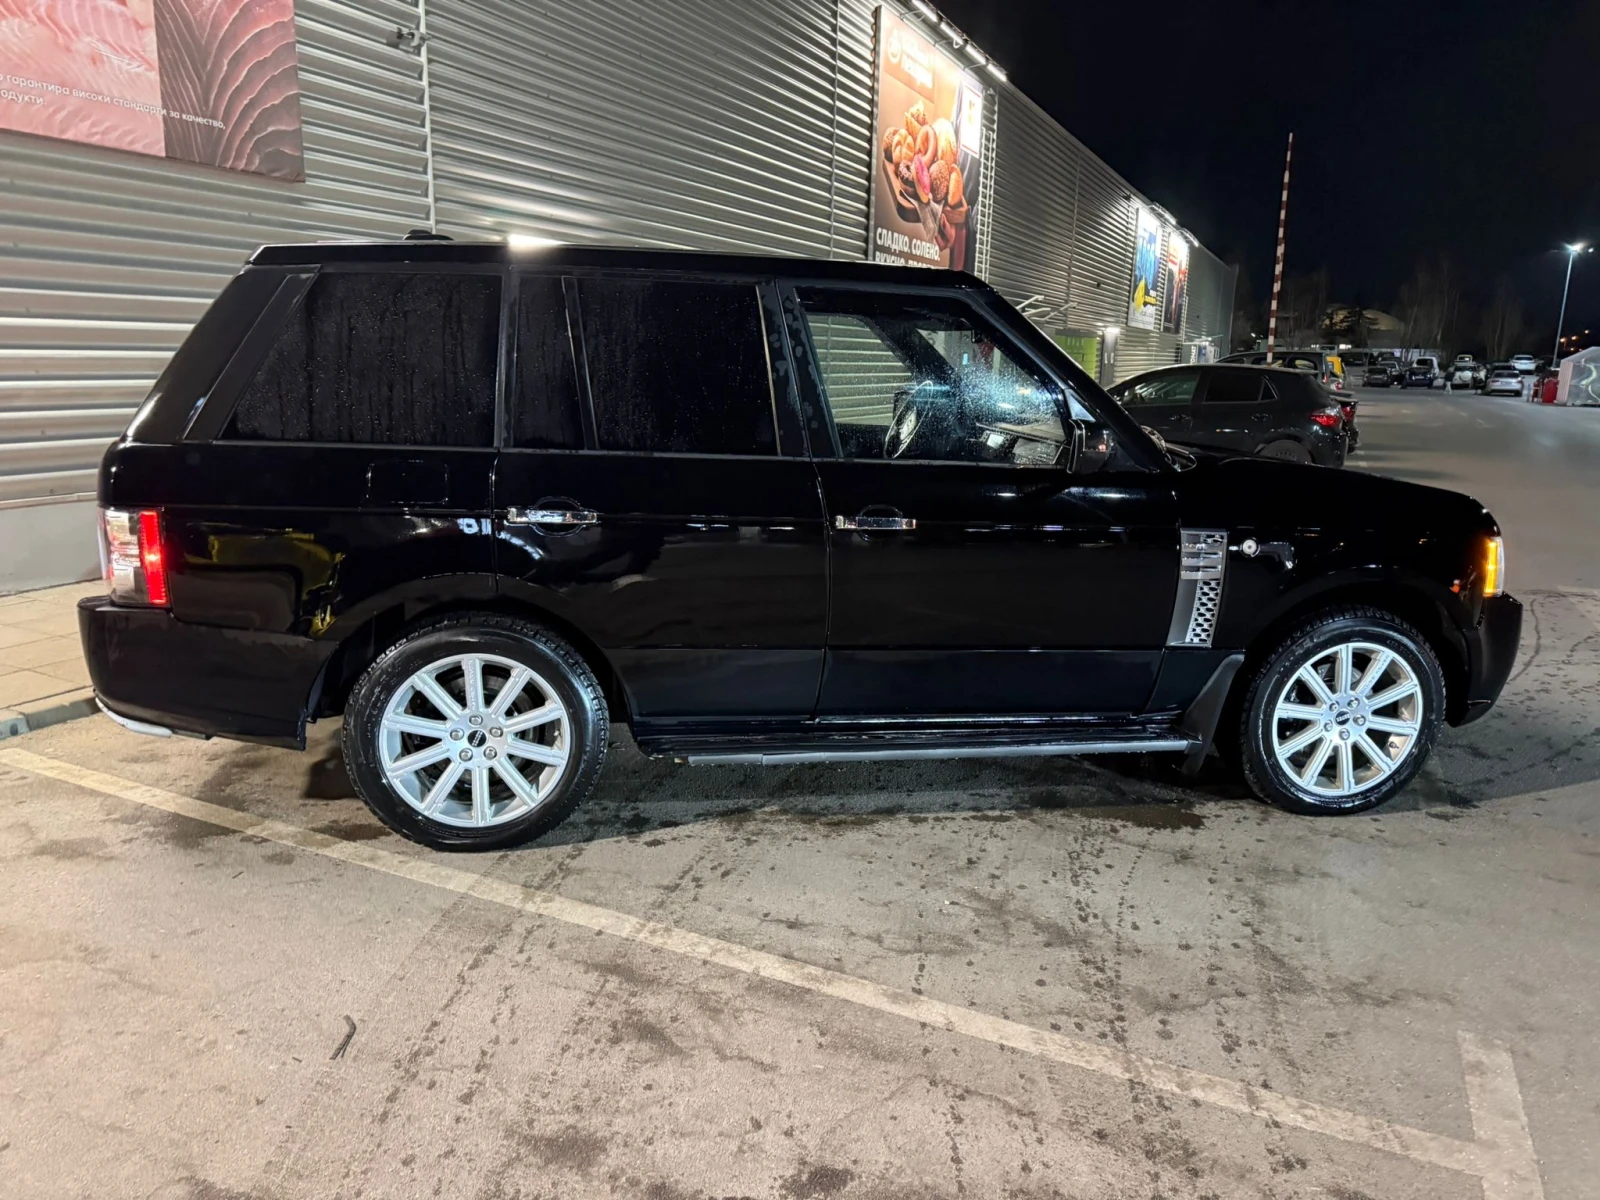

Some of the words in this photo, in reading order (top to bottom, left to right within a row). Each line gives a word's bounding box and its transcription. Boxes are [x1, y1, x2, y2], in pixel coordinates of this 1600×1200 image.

[6, 74, 70, 95] гарантира
[72, 88, 111, 104] високи
[113, 98, 167, 116] стандарти
[169, 110, 180, 119] за
[182, 113, 226, 130] качество,
[876, 227, 911, 254] СЛАДКО.
[911, 238, 940, 261] СОЛЕНО.
